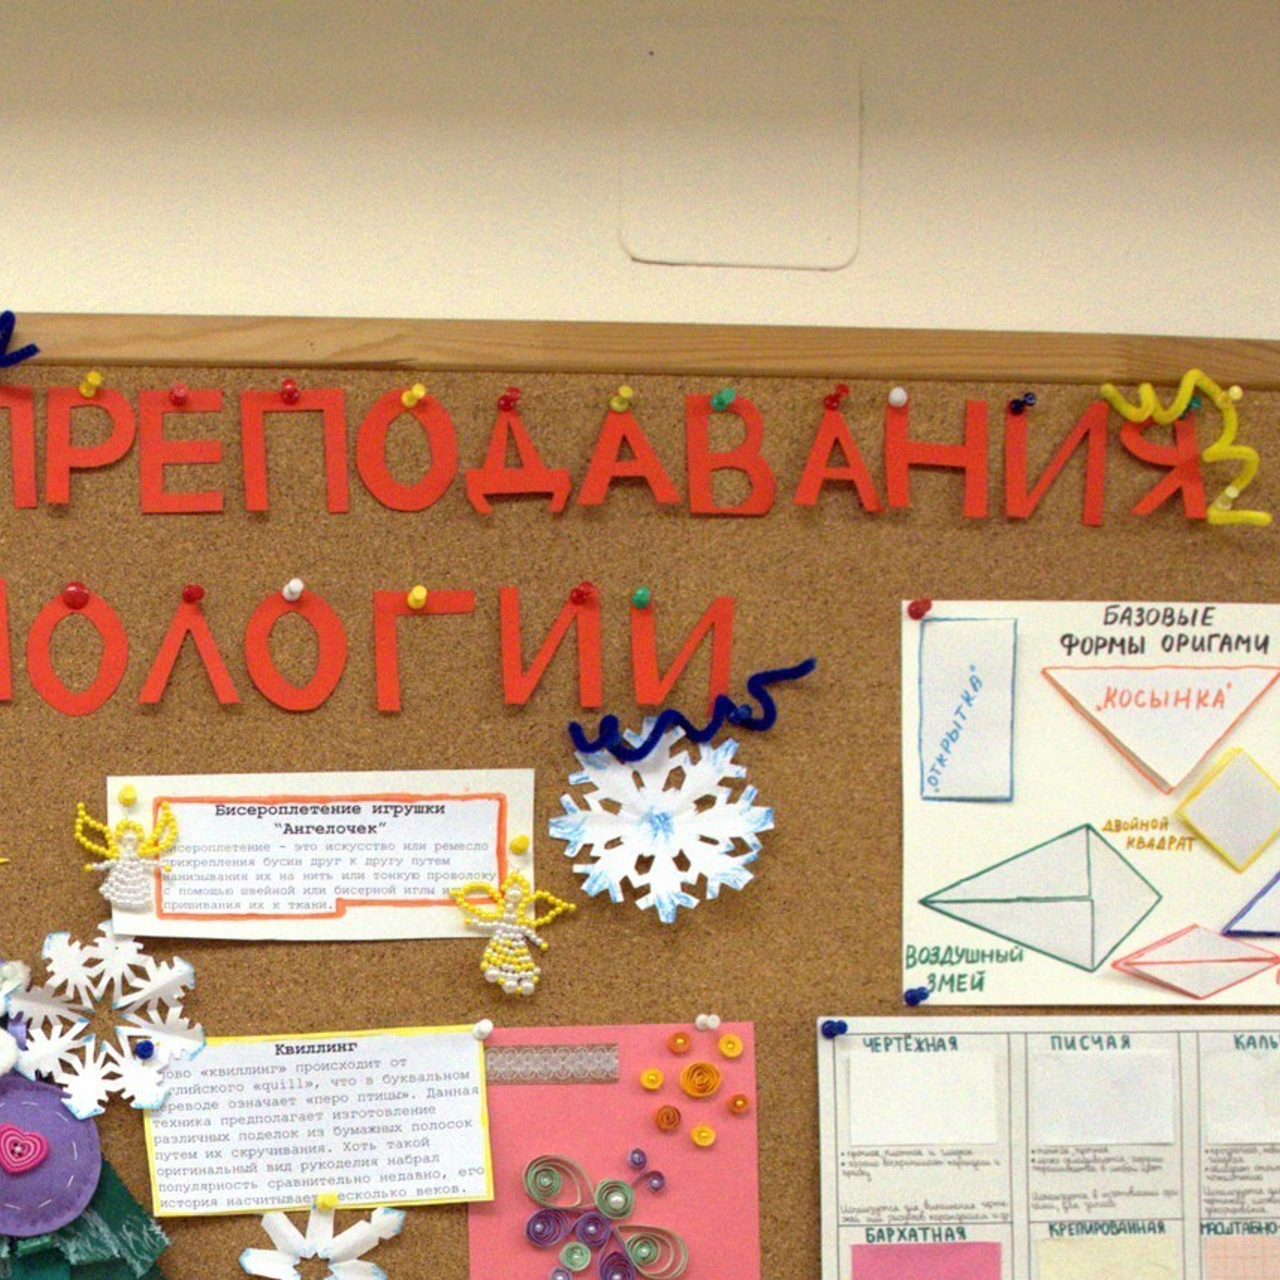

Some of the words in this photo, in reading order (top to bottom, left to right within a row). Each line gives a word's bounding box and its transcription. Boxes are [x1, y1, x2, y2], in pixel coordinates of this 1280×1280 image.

[1103, 604, 1215, 628] БАЗОВЫЕ
[1060, 633, 1145, 655] ФОРМЫ
[1162, 633, 1269, 654] ОРИГАМИ
[215, 803, 360, 818] Бисероплетение
[370, 805, 445, 817] игрушки
[1101, 816, 1169, 833] ДВОЙНОЙ
[161, 843, 271, 855] исероплетение
[1126, 835, 1197, 852] КВАДРАТ
[926, 971, 984, 993] ЗМЕЙ
[275, 1041, 358, 1054] Квиллинг
[863, 1034, 958, 1052] ЧЕРТЁЖНАЯ
[1051, 1035, 1131, 1051] ПИСЧАЯ
[865, 1227, 966, 1243] БАРХАТНАЯ
[1049, 1220, 1166, 1237] КРЕПИРОВАННАЯ
